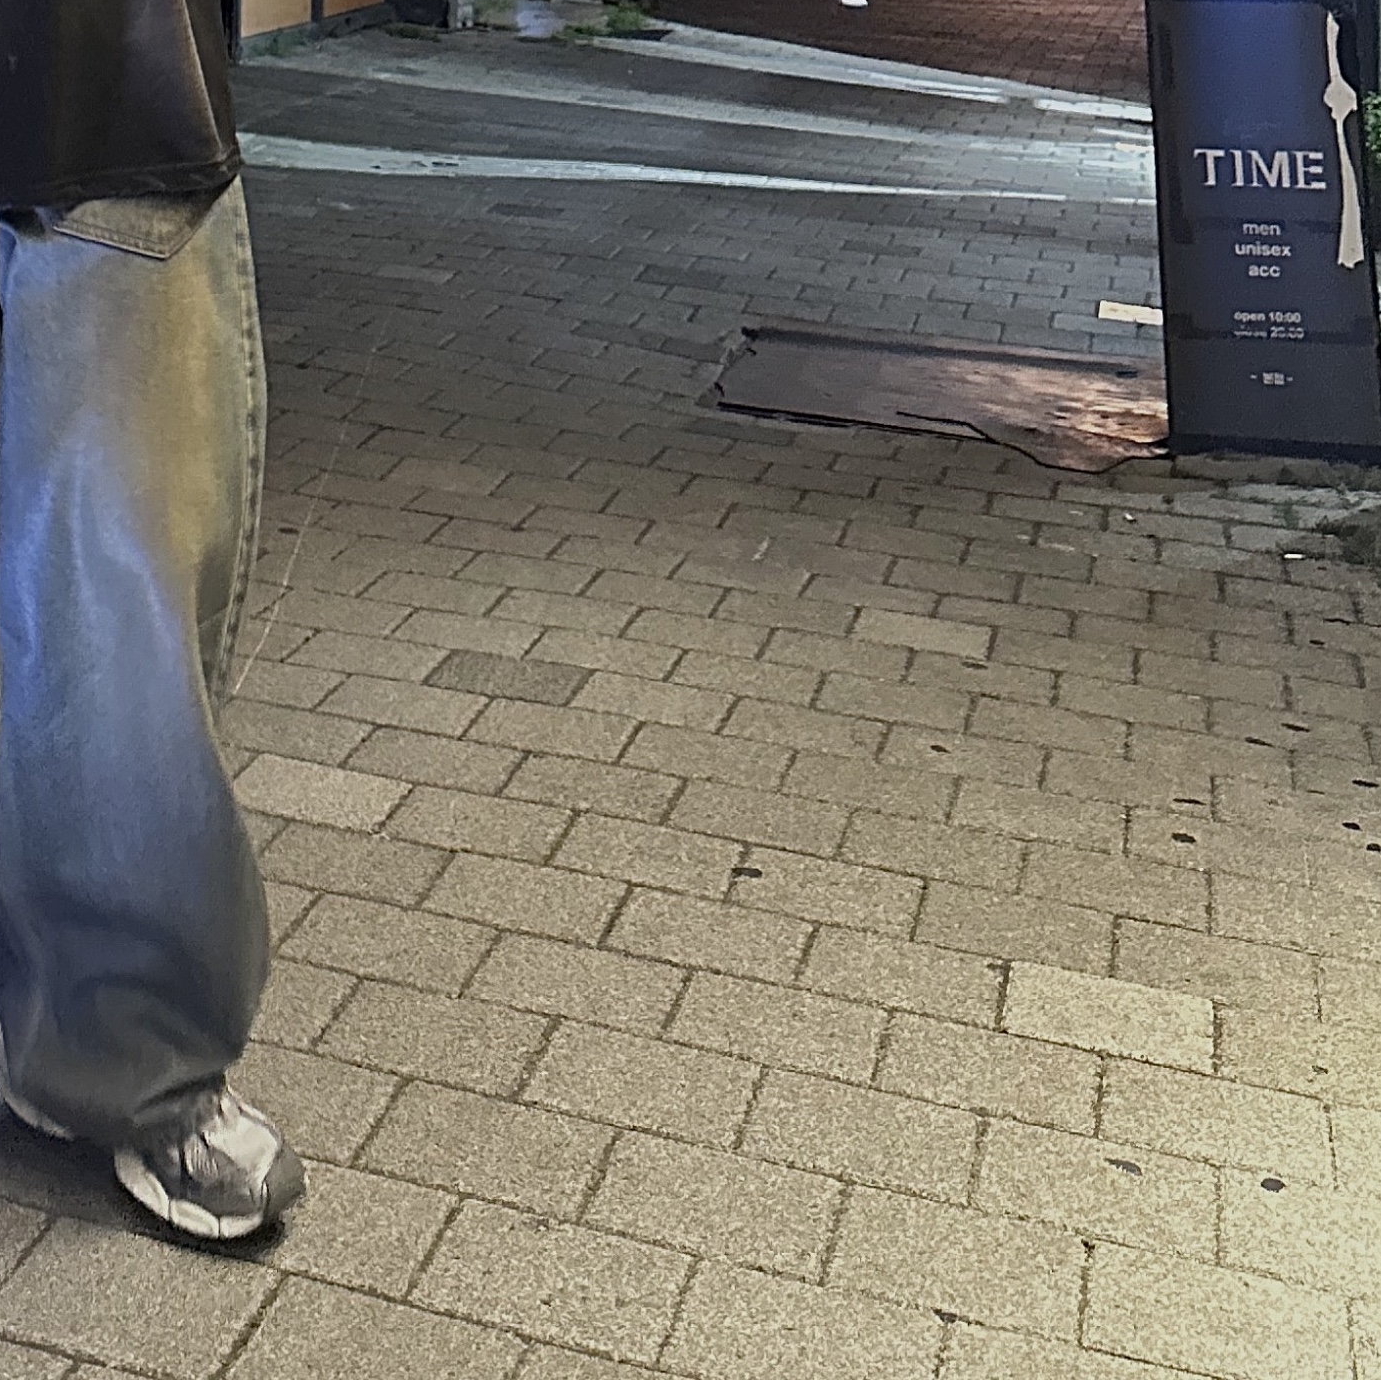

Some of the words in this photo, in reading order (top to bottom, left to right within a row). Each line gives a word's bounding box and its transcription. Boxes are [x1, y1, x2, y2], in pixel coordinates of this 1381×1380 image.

[1194, 148, 1328, 190] TIME
[1242, 222, 1281, 236] men
[1235, 241, 1292, 257] unisex
[1248, 264, 1281, 277] acc
[1233, 311, 1266, 323] open
